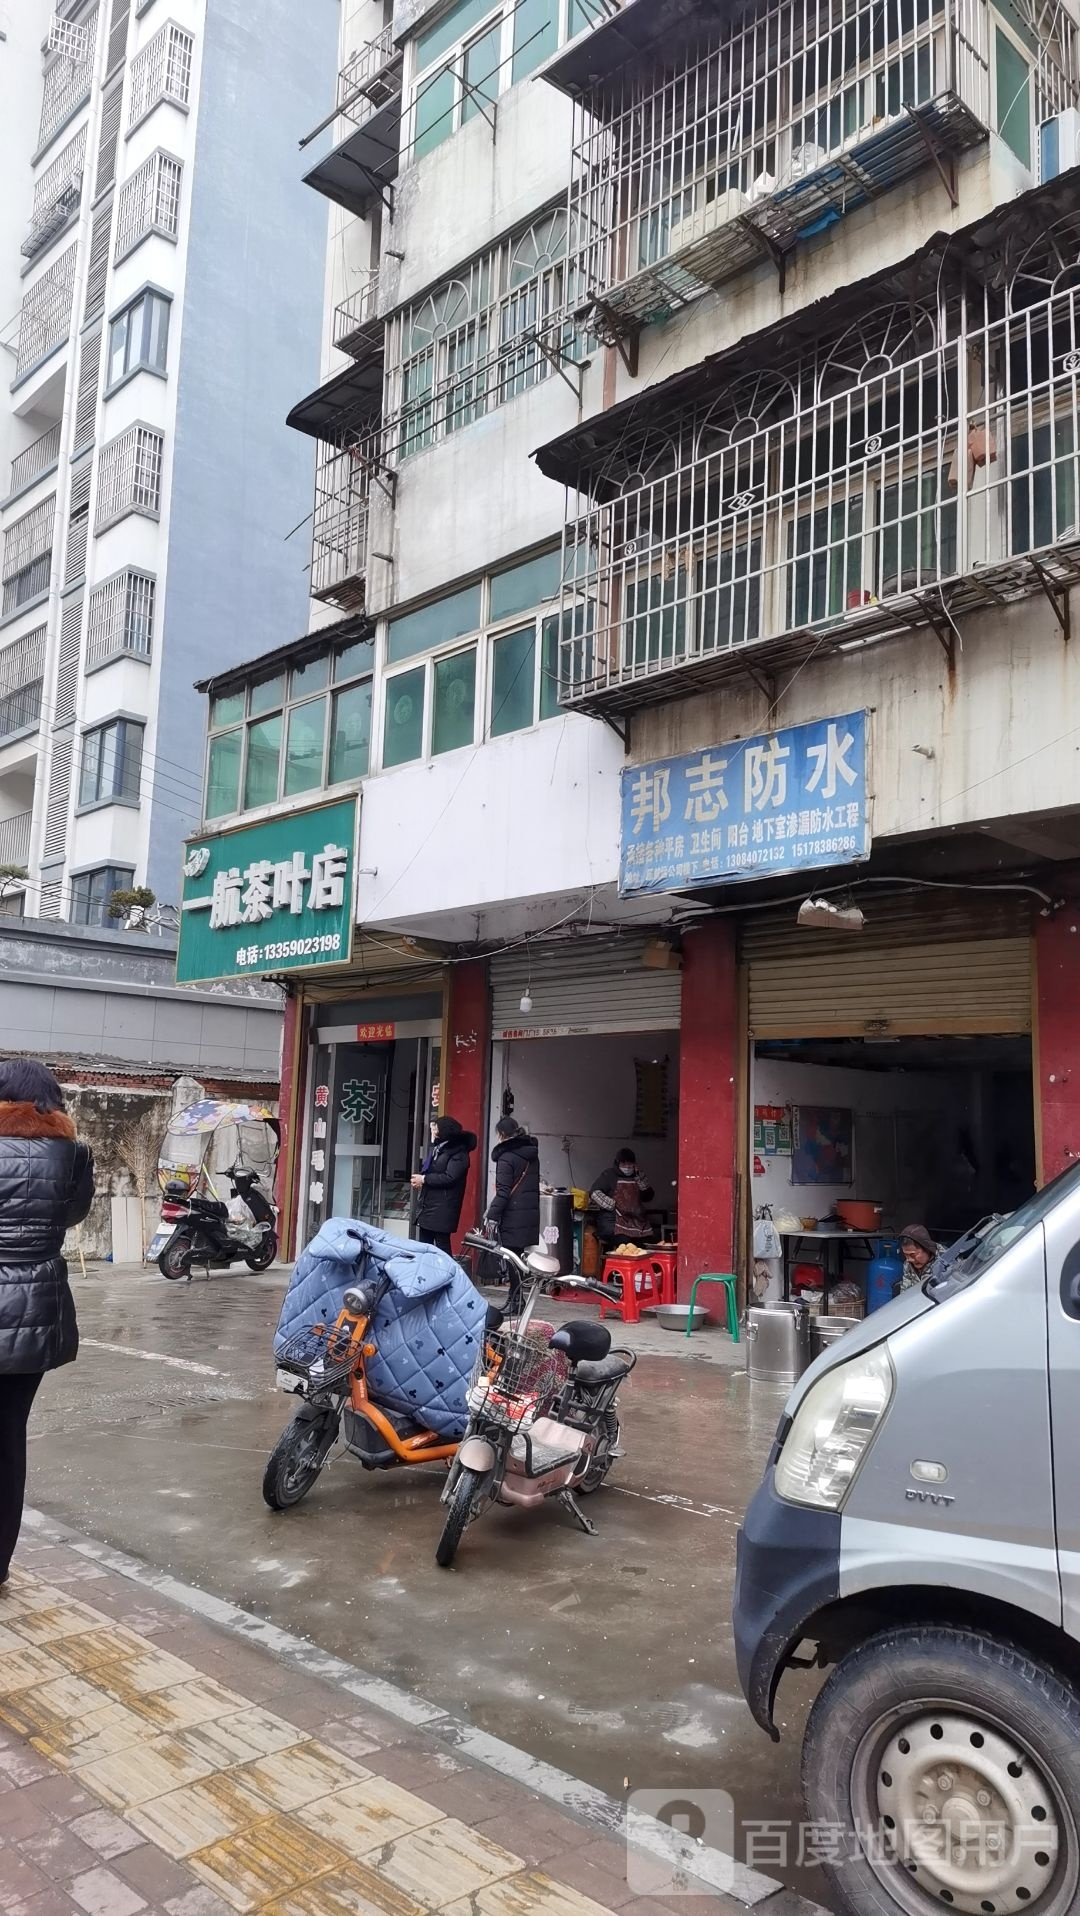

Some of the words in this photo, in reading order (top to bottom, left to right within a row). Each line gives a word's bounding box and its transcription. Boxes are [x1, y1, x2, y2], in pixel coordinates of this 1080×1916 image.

[631, 724, 858, 835] 邦志防水
[690, 828, 721, 855] 卫生间
[727, 822, 749, 848] 阳台
[752, 802, 859, 843] 地下室渗漏防水工程
[791, 835, 856, 857] 15178386286
[182, 843, 349, 929] 一航茶叶店
[236, 933, 341, 966] 电话:13359023198
[359, 1025, 393, 1039] 欢迎光临
[341, 1079, 377, 1124] 茶
